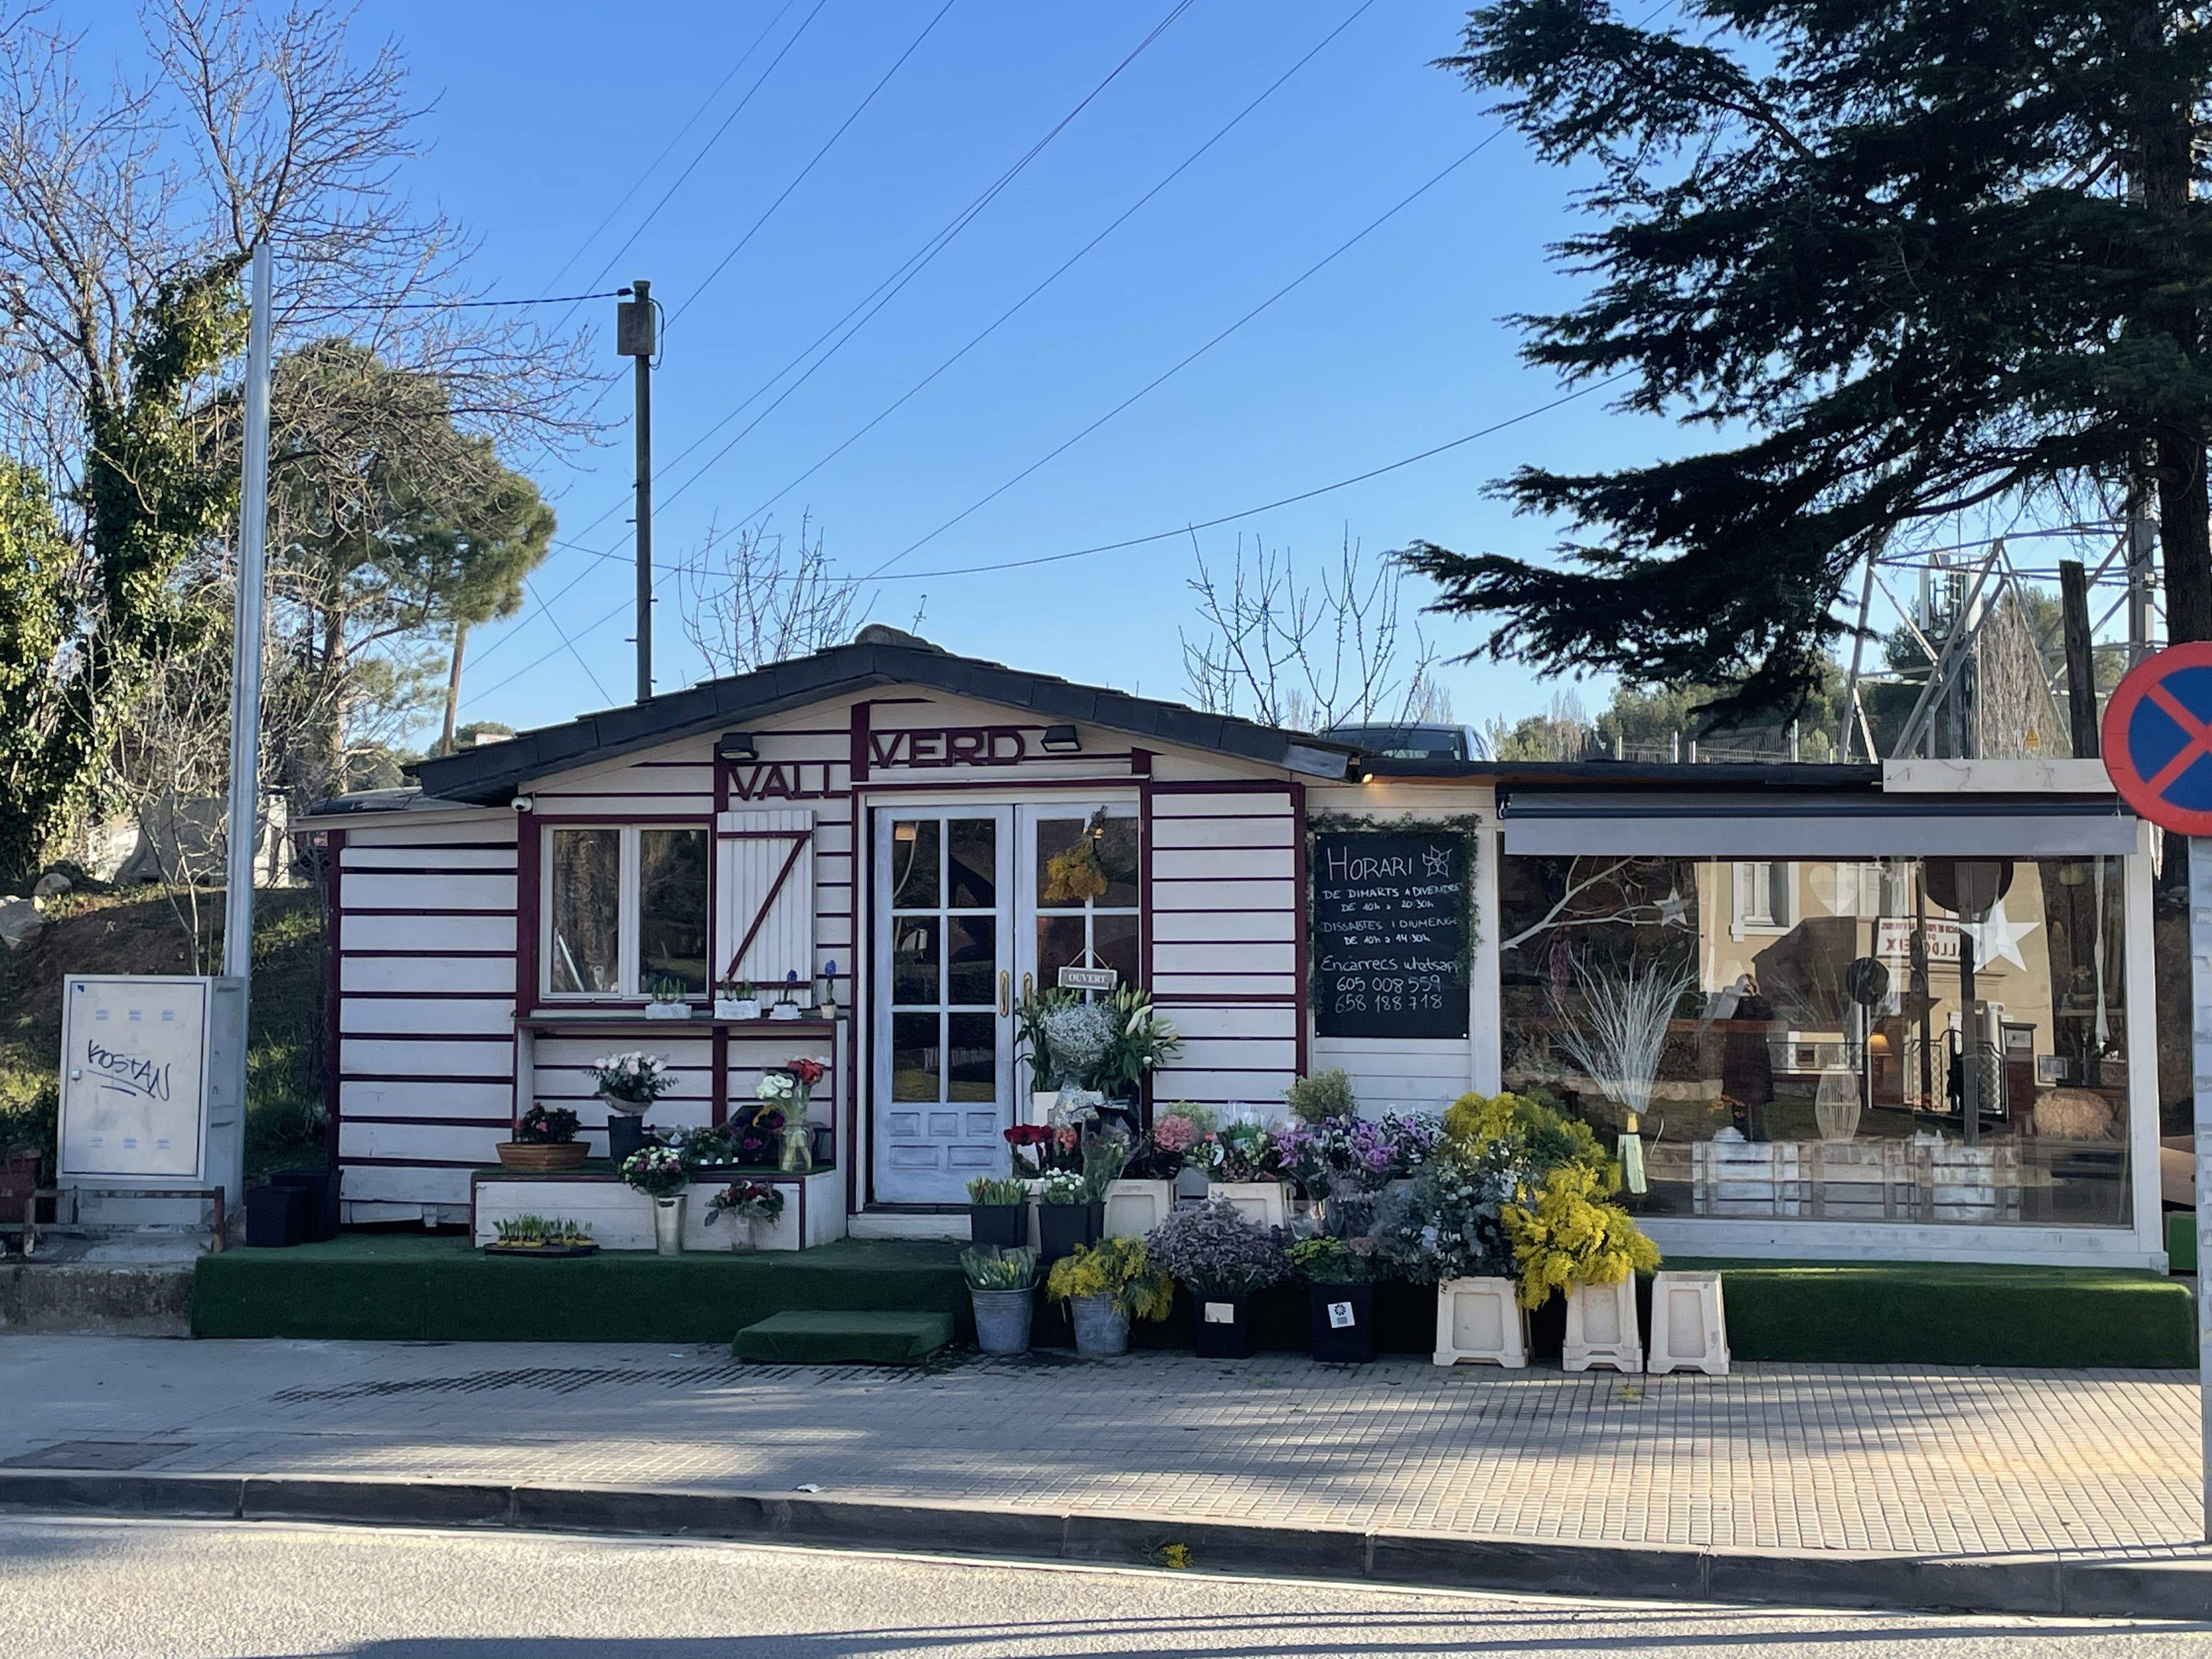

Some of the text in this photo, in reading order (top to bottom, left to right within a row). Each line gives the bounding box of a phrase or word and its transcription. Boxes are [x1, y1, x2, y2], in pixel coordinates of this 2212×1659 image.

[728, 730, 1025, 801] VALL VERD
[1327, 846, 1413, 881] HORARI
[1322, 890, 1342, 900] DE
[1348, 887, 1400, 899] DIMARTS
[1341, 902, 1357, 912] DE
[1322, 919, 1384, 933] DISSABTES
[1344, 935, 1358, 945] DE
[1068, 973, 1107, 984] OUVERT
[1336, 974, 1442, 994] 605 008 559
[1335, 994, 1443, 1014] 658 188 718
